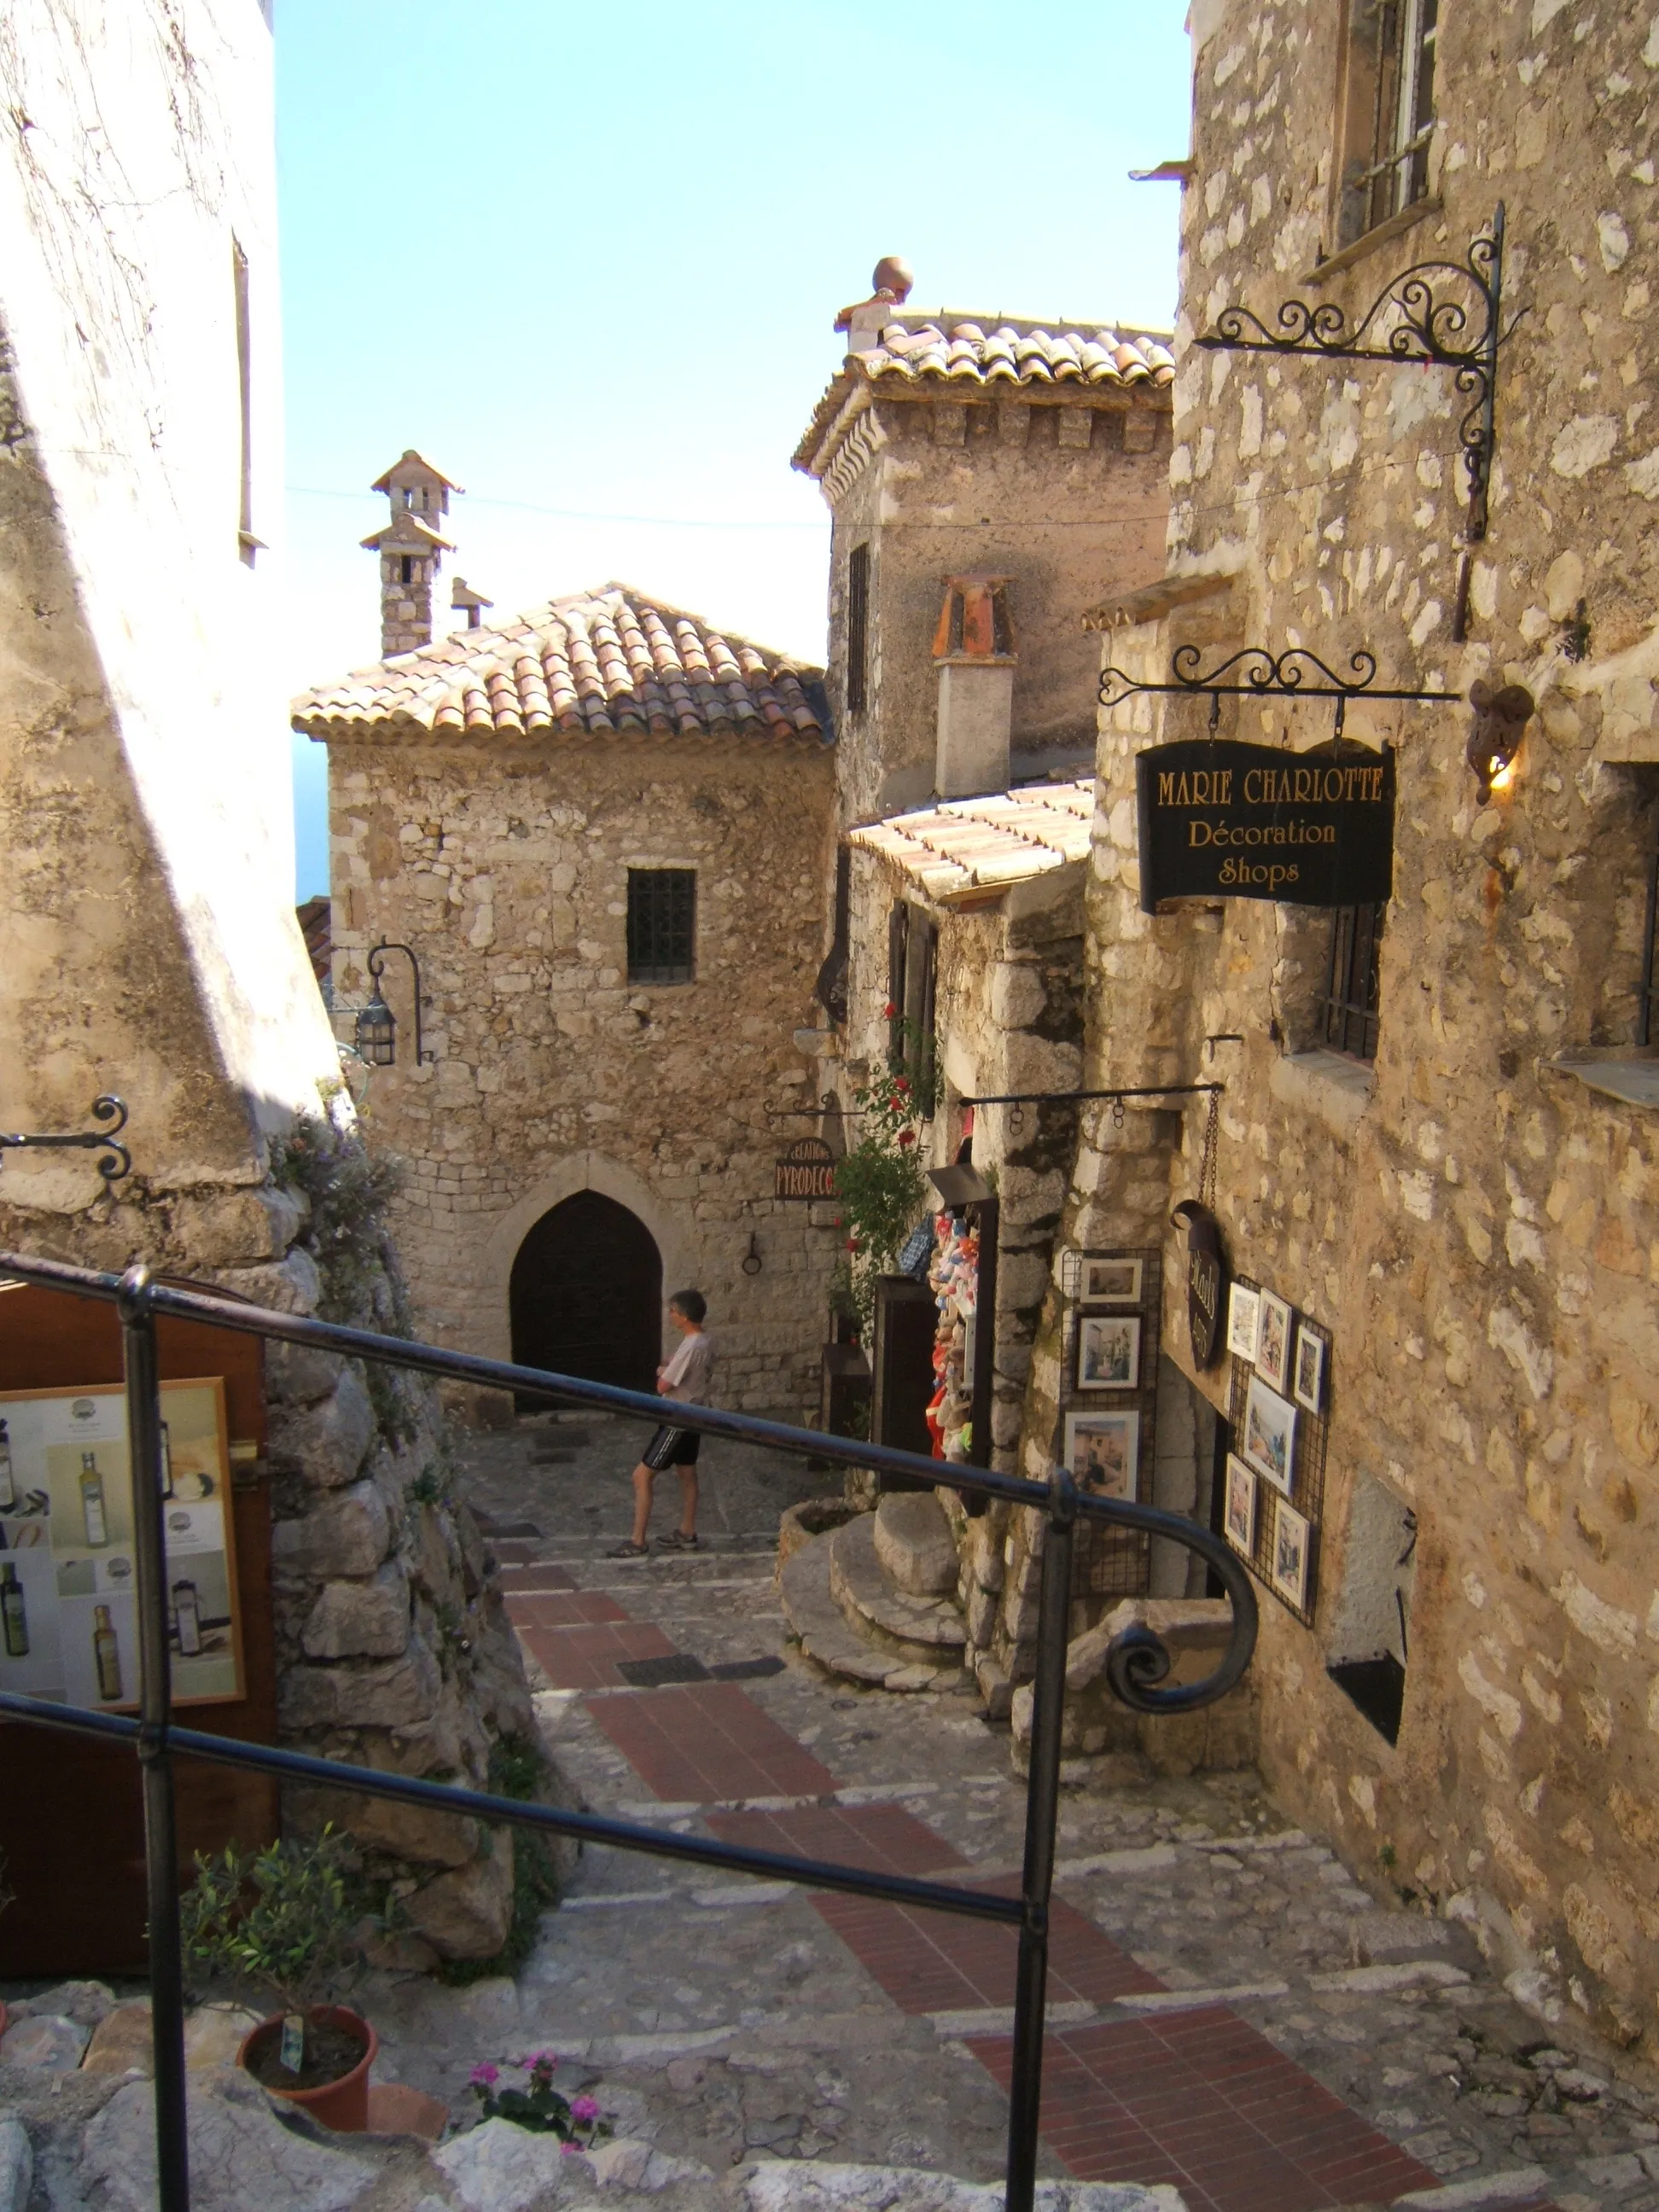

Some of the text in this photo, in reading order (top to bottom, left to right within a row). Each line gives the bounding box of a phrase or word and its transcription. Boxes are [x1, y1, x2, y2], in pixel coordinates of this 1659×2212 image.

[1158, 766, 1383, 806] MARIE CHARLOTTE
[1189, 819, 1336, 847] Décoration
[1219, 857, 1299, 892] Shops
